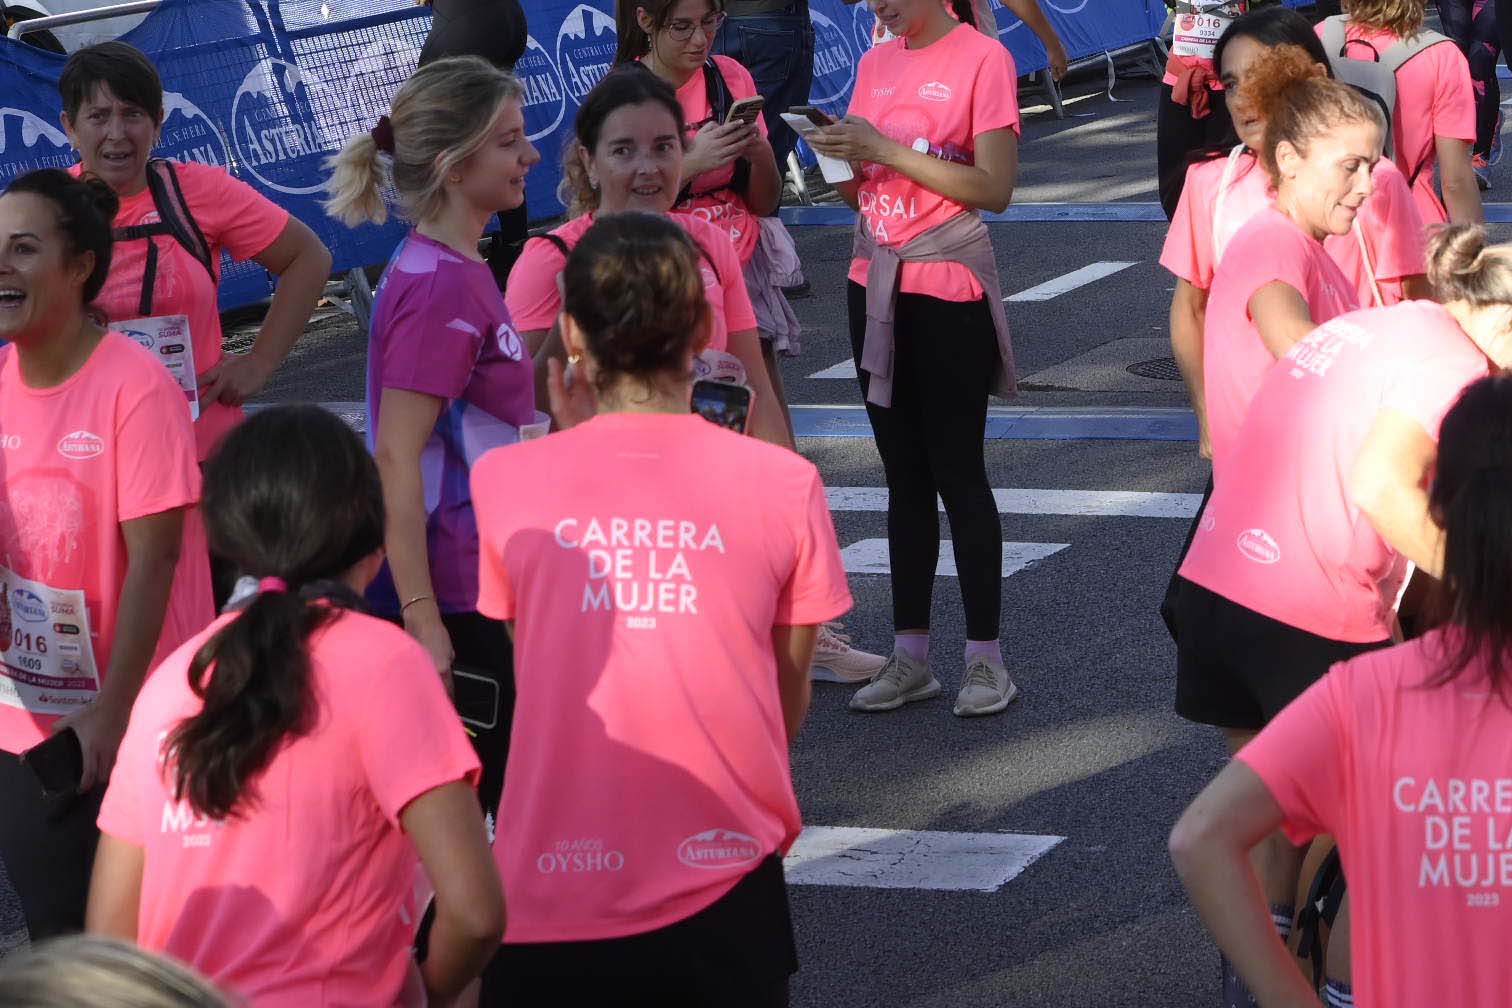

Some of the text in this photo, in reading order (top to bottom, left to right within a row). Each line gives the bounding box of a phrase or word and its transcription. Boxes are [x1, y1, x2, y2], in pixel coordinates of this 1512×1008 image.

[1197, 17, 1221, 29] 016
[554, 516, 726, 554] CARRERA
[588, 549, 693, 581] DE LA
[580, 581, 699, 615] MUJER
[14, 628, 48, 654] 016
[1425, 815, 1472, 851] DE
[536, 850, 625, 874] OYSHO
